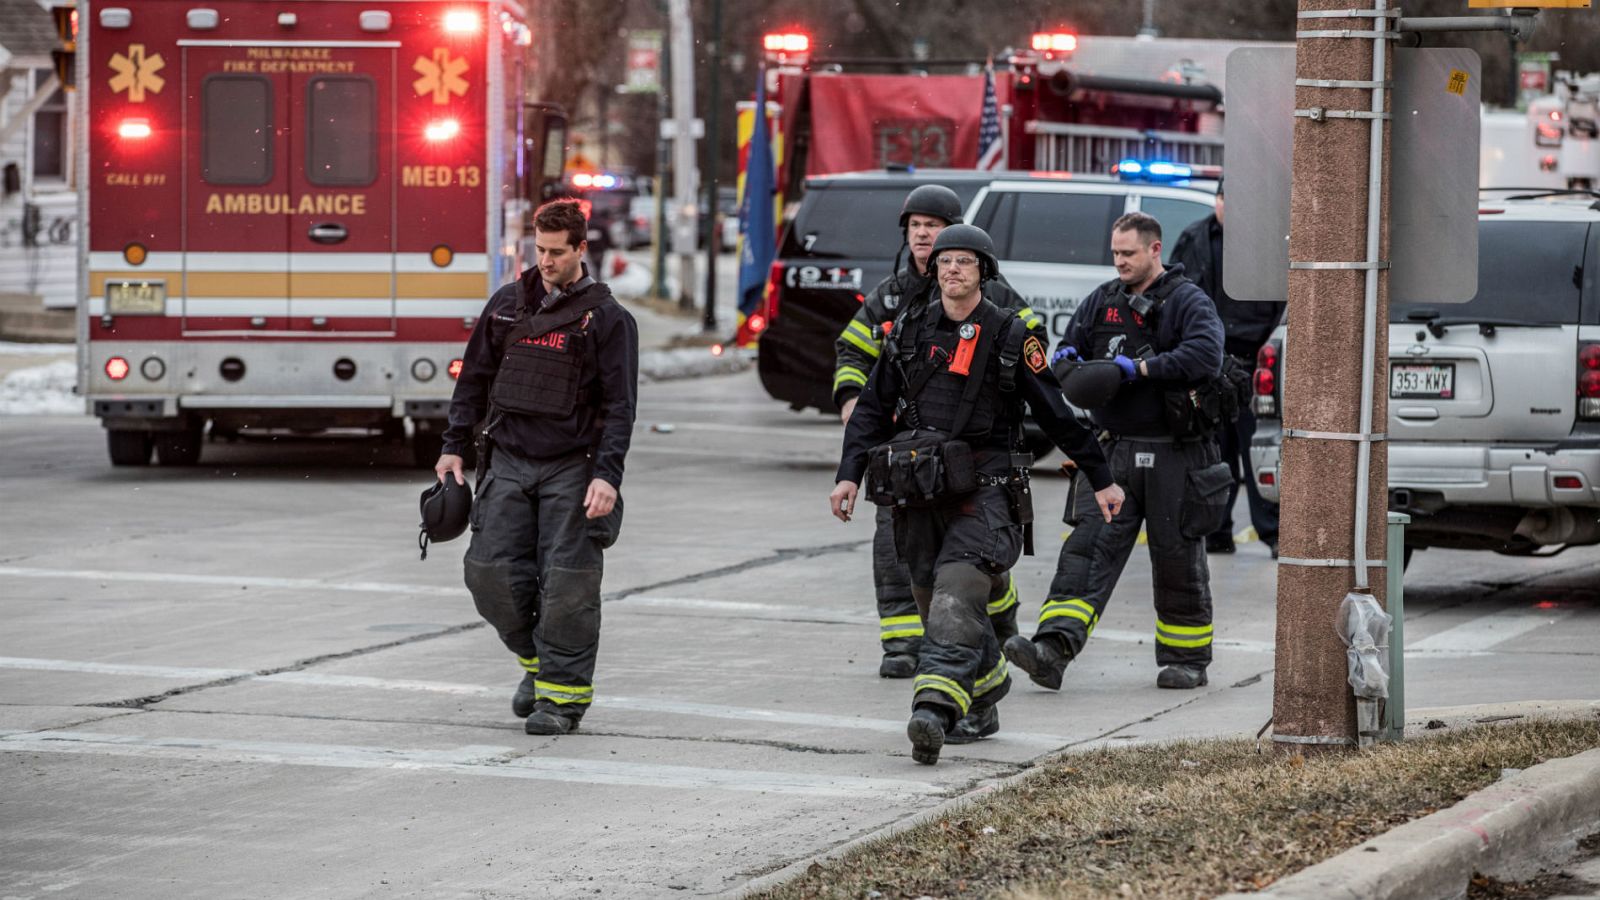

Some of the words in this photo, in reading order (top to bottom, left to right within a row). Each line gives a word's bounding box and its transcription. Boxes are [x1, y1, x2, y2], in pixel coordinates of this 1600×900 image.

[247, 48, 331, 59] MILWAUKEE
[223, 61, 256, 72] FIRE
[260, 61, 355, 72] DEPARTMENT
[106, 174, 138, 186] CALL
[143, 174, 166, 186] 911
[402, 165, 450, 187] MED
[457, 165, 481, 187] 13
[205, 194, 366, 215] AMBULANCE
[804, 234, 817, 251] 7
[799, 265, 863, 290] 911
